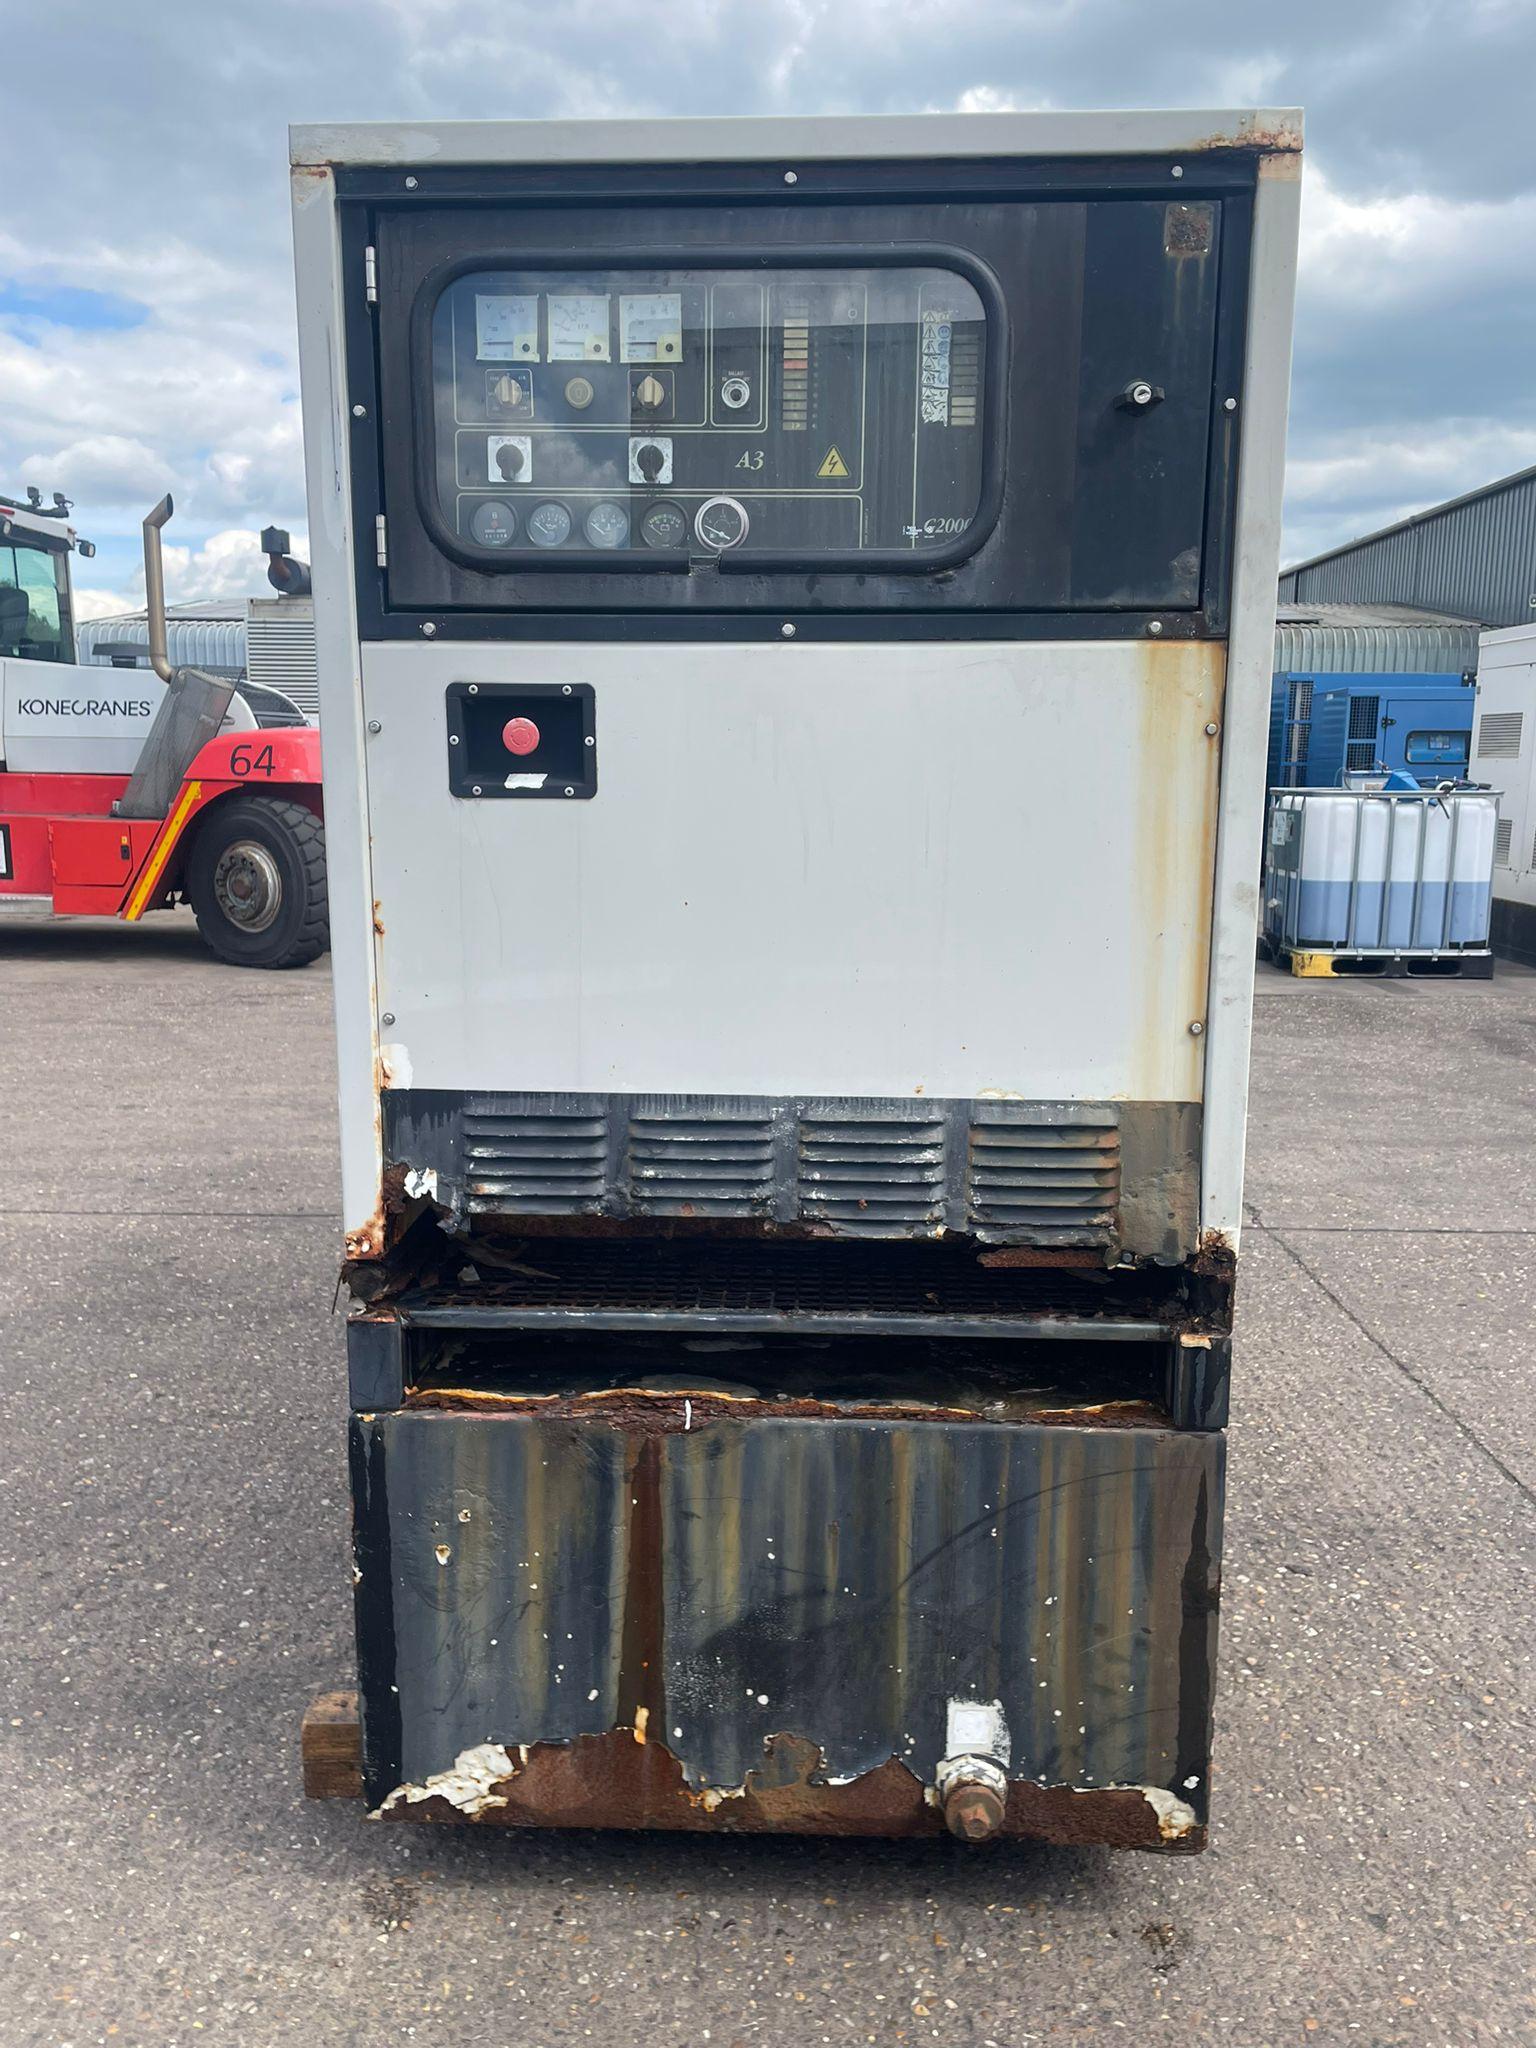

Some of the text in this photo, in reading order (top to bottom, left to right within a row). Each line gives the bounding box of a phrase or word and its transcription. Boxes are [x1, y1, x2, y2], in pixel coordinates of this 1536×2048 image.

[735, 450, 765, 471] A3
[18, 699, 151, 717] KONECRANES
[229, 744, 276, 777] 64
